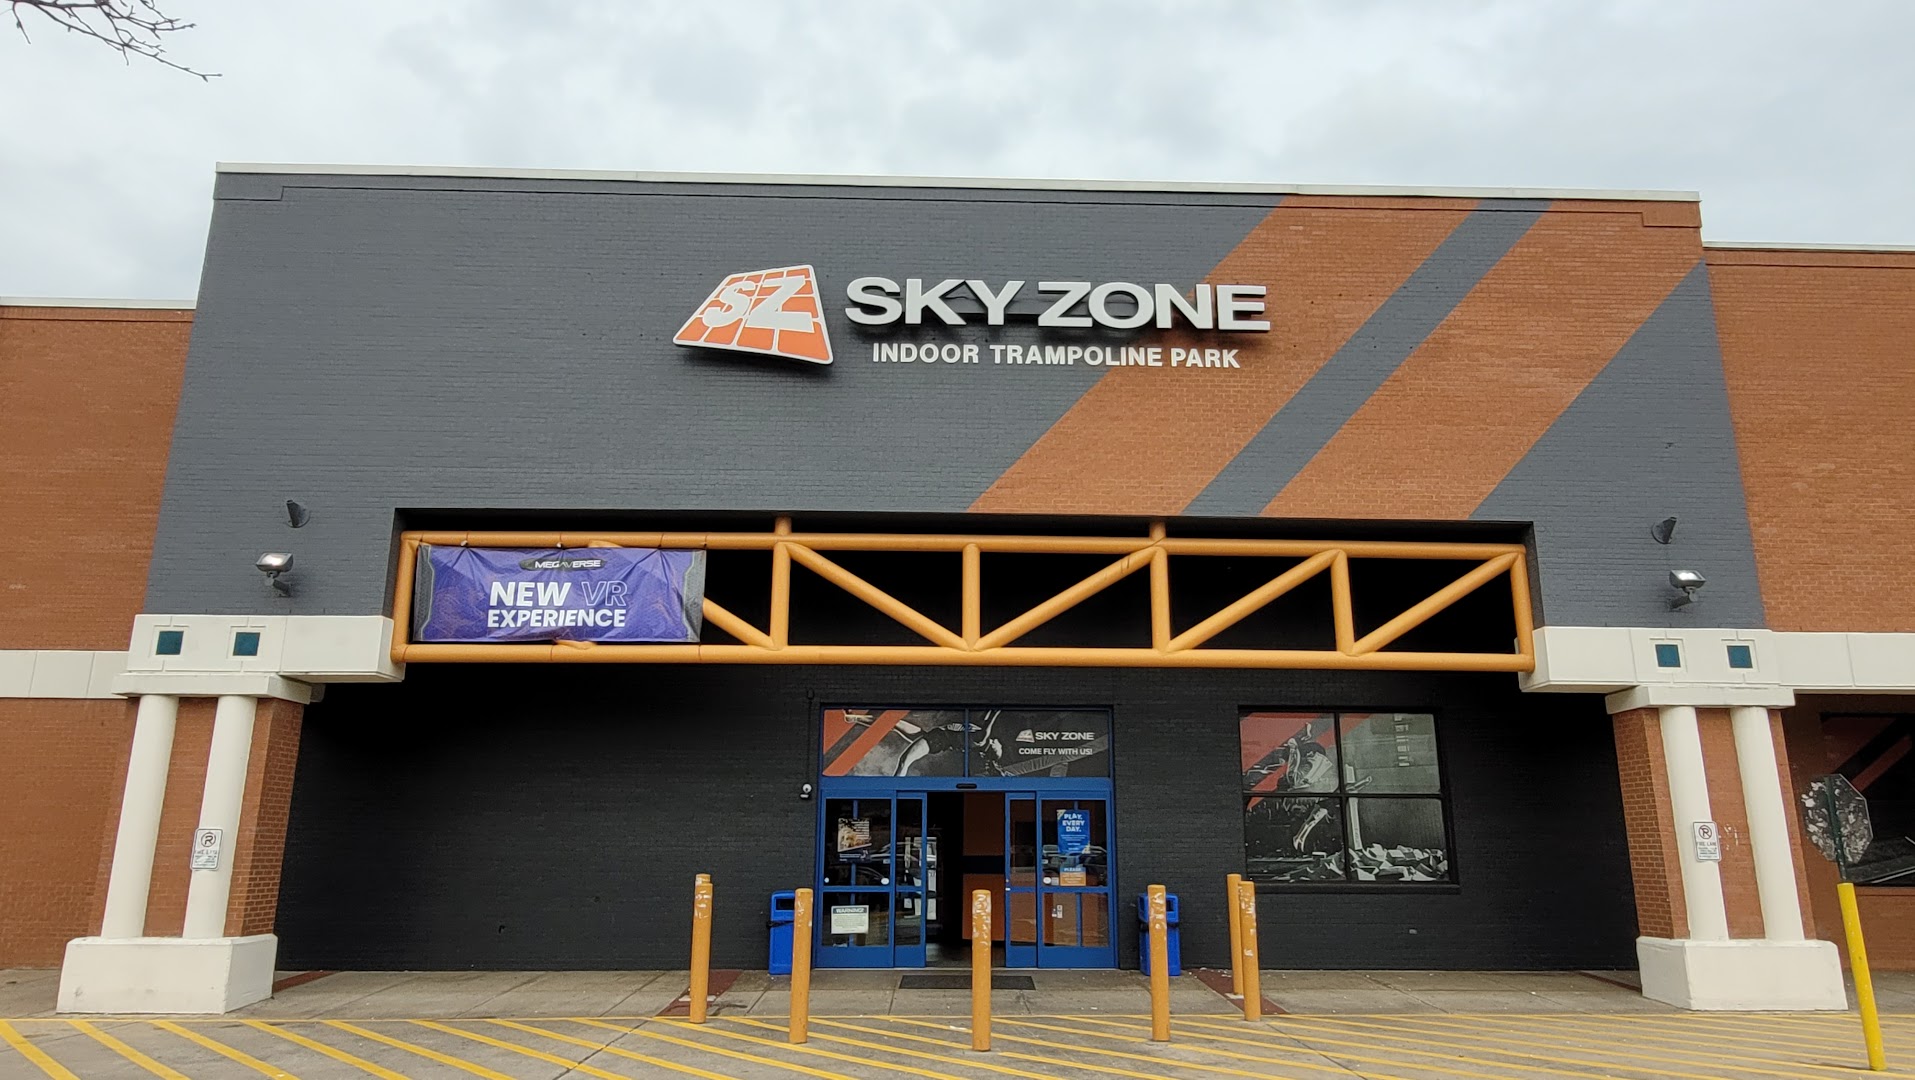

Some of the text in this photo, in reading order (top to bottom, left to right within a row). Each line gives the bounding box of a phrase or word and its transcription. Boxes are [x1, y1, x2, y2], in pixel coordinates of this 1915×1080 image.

[702, 276, 815, 333] SZ
[845, 276, 1271, 331] SKY ZONE
[872, 342, 1241, 368] INDOOR TRAMPOLINE PARK
[534, 560, 602, 569] MEGAVERSE
[489, 580, 628, 607] NEW VR
[487, 608, 627, 628] EXPERIENCE
[1035, 731, 1060, 741] SKY
[1061, 731, 1095, 741] ZONE
[1018, 747, 1093, 756] COME FLY WITH US!
